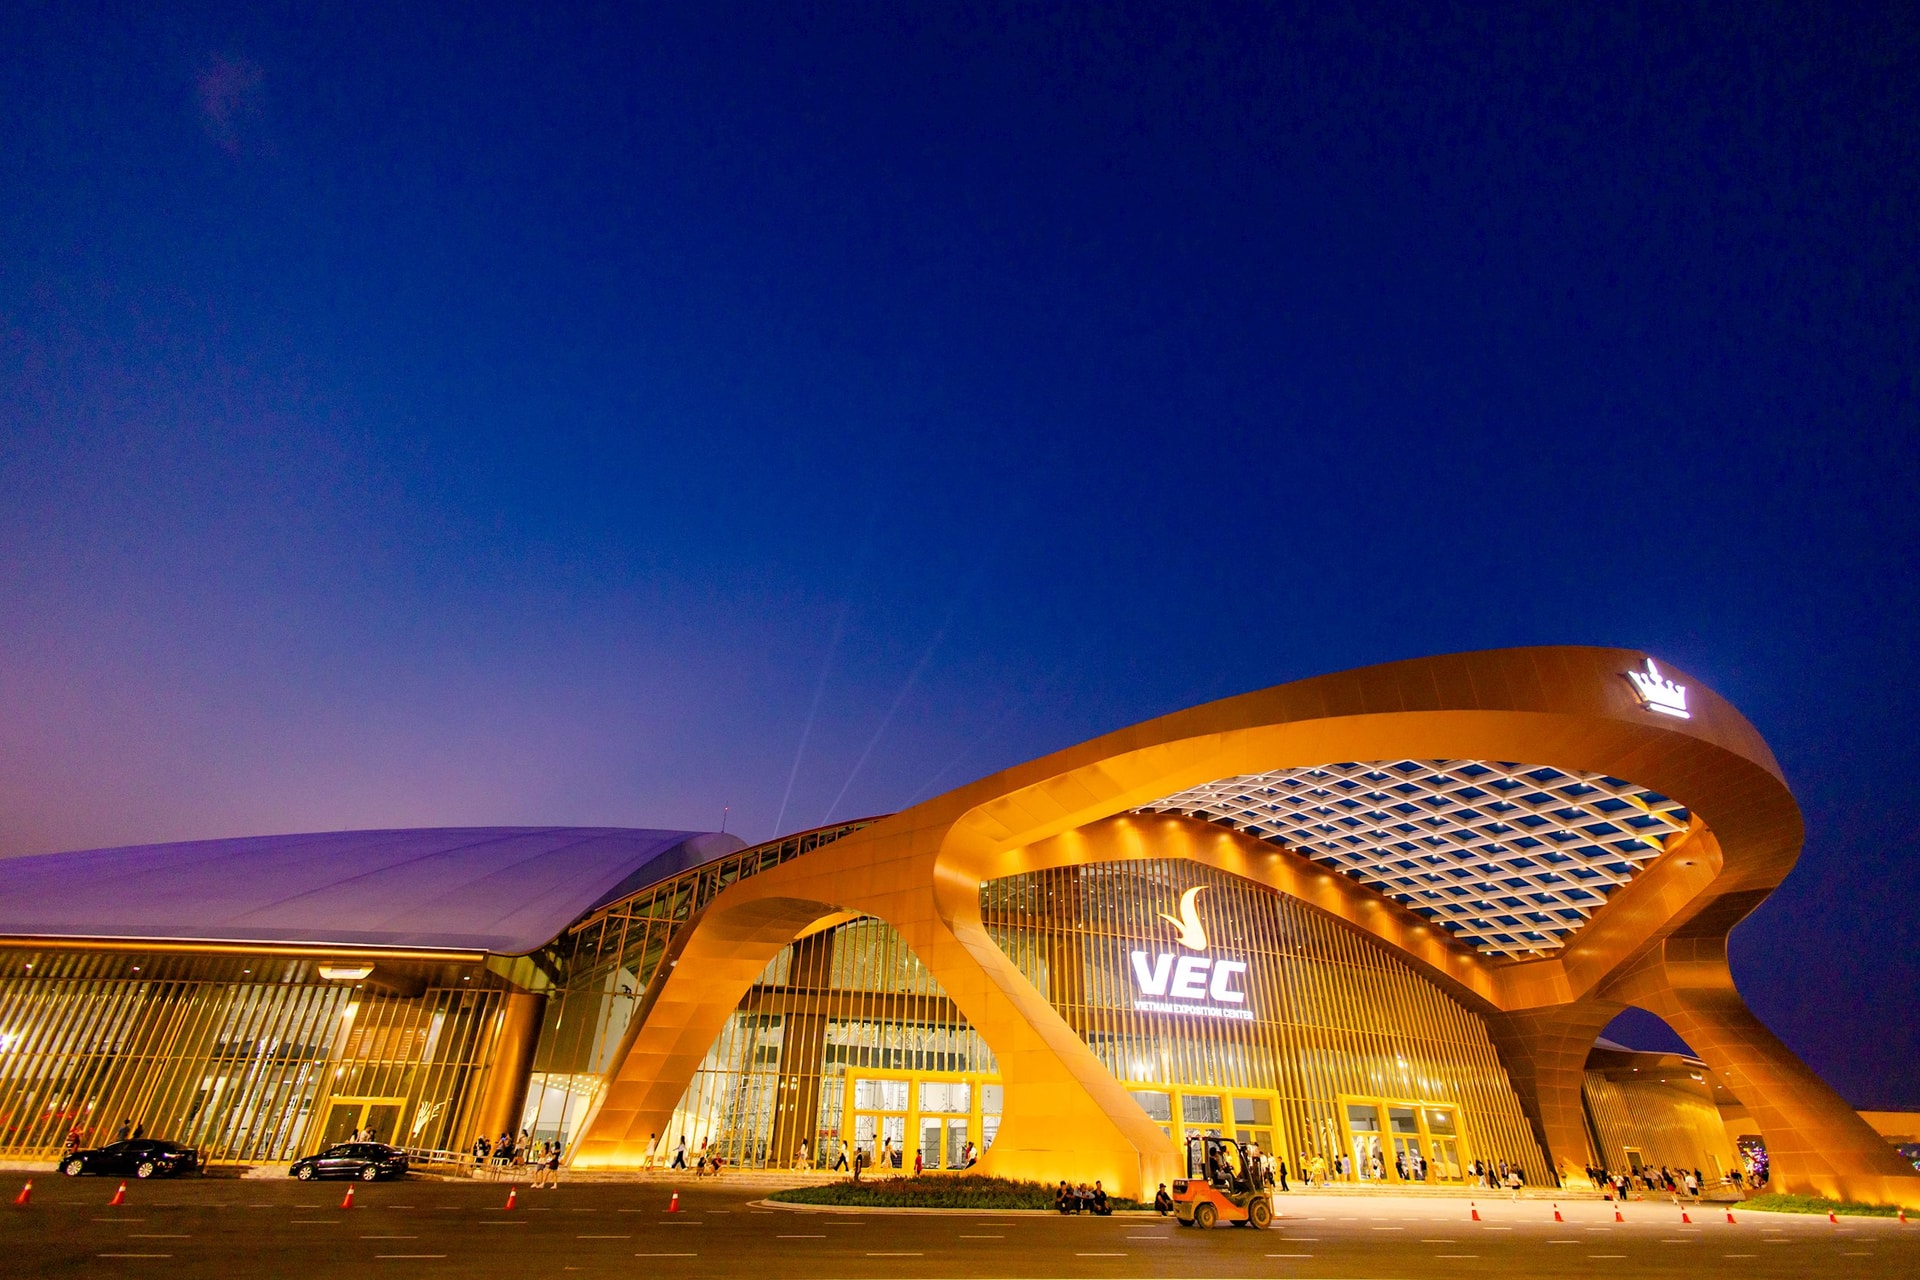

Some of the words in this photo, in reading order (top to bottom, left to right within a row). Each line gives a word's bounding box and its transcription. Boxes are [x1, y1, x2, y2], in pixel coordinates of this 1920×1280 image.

[1131, 951, 1247, 1002] VEC
[1134, 1001, 1173, 1012] VIETNAM
[1174, 1004, 1222, 1017] EXPOSITION
[1222, 1008, 1254, 1020] CENTER
